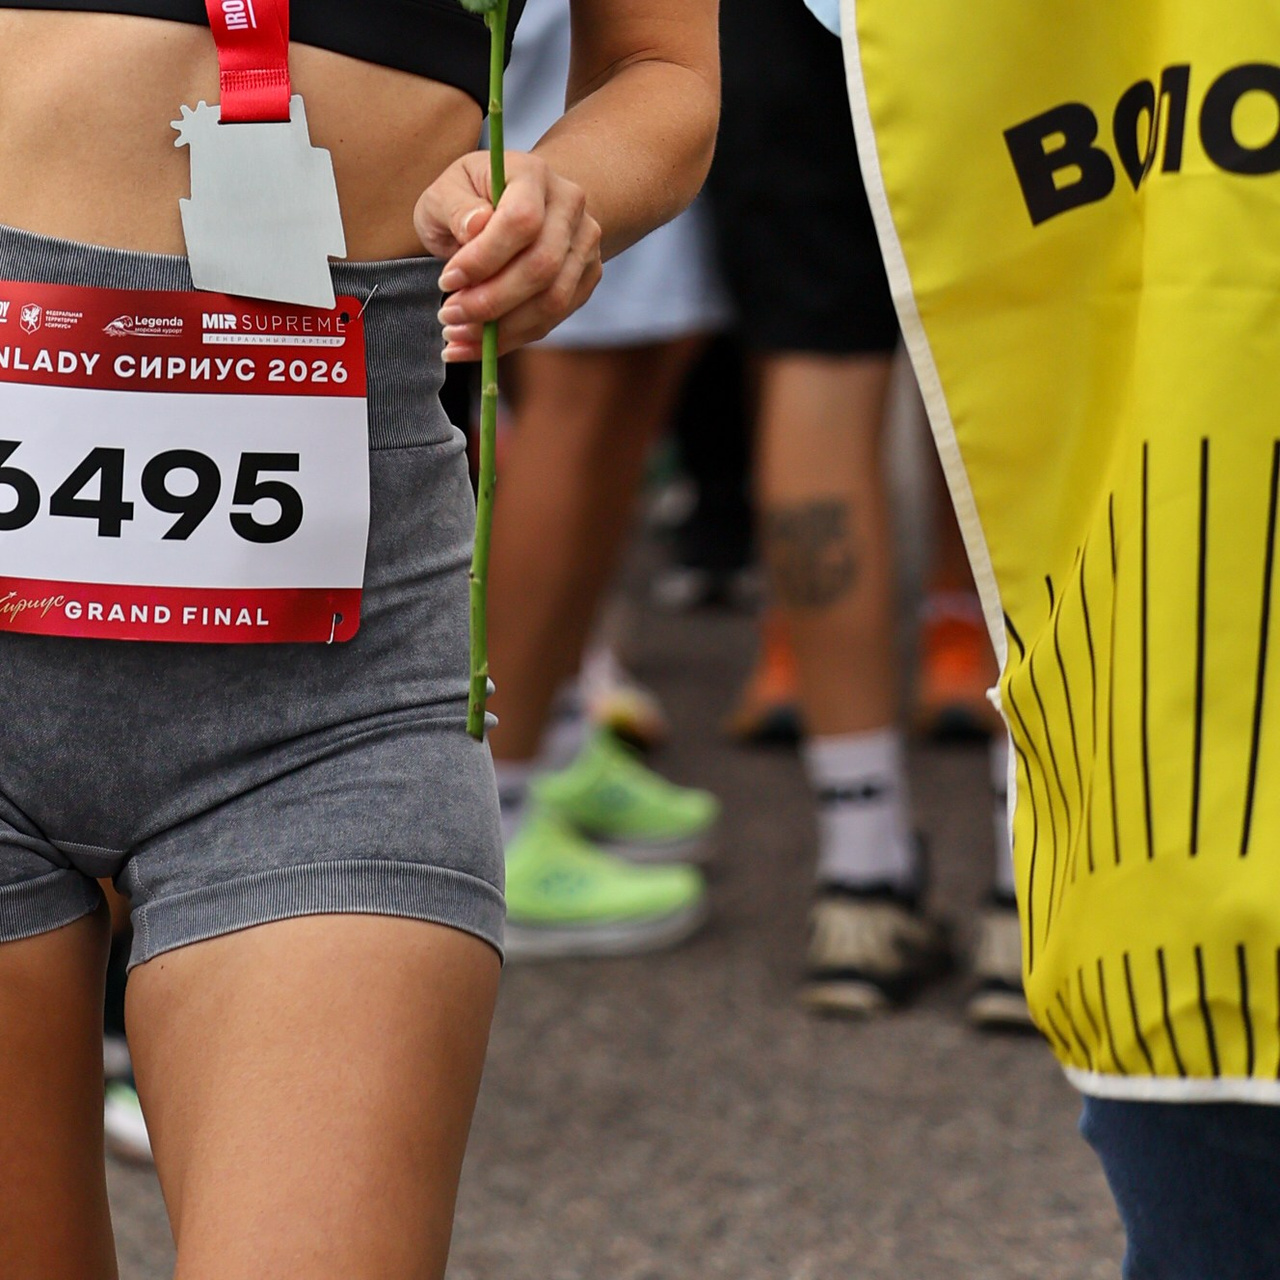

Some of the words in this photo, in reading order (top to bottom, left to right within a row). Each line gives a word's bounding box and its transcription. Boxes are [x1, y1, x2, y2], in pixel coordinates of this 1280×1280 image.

[45, 310, 83, 318] ФЕДЕРАЛЬНАЯ
[45, 316, 78, 324] ТЕРРИТОРИЯ
[135, 315, 183, 328] Legenda
[202, 313, 237, 330] MIR
[241, 314, 346, 333] SUPREME
[208, 335, 286, 343] ГЕНЕРАЛЬНЫЙ
[293, 337, 340, 345] ПАРТНЕР
[113, 355, 256, 382] СИРИУС
[268, 358, 349, 384] 2026
[64, 601, 171, 624] GRAND
[182, 607, 269, 626] FINAL
